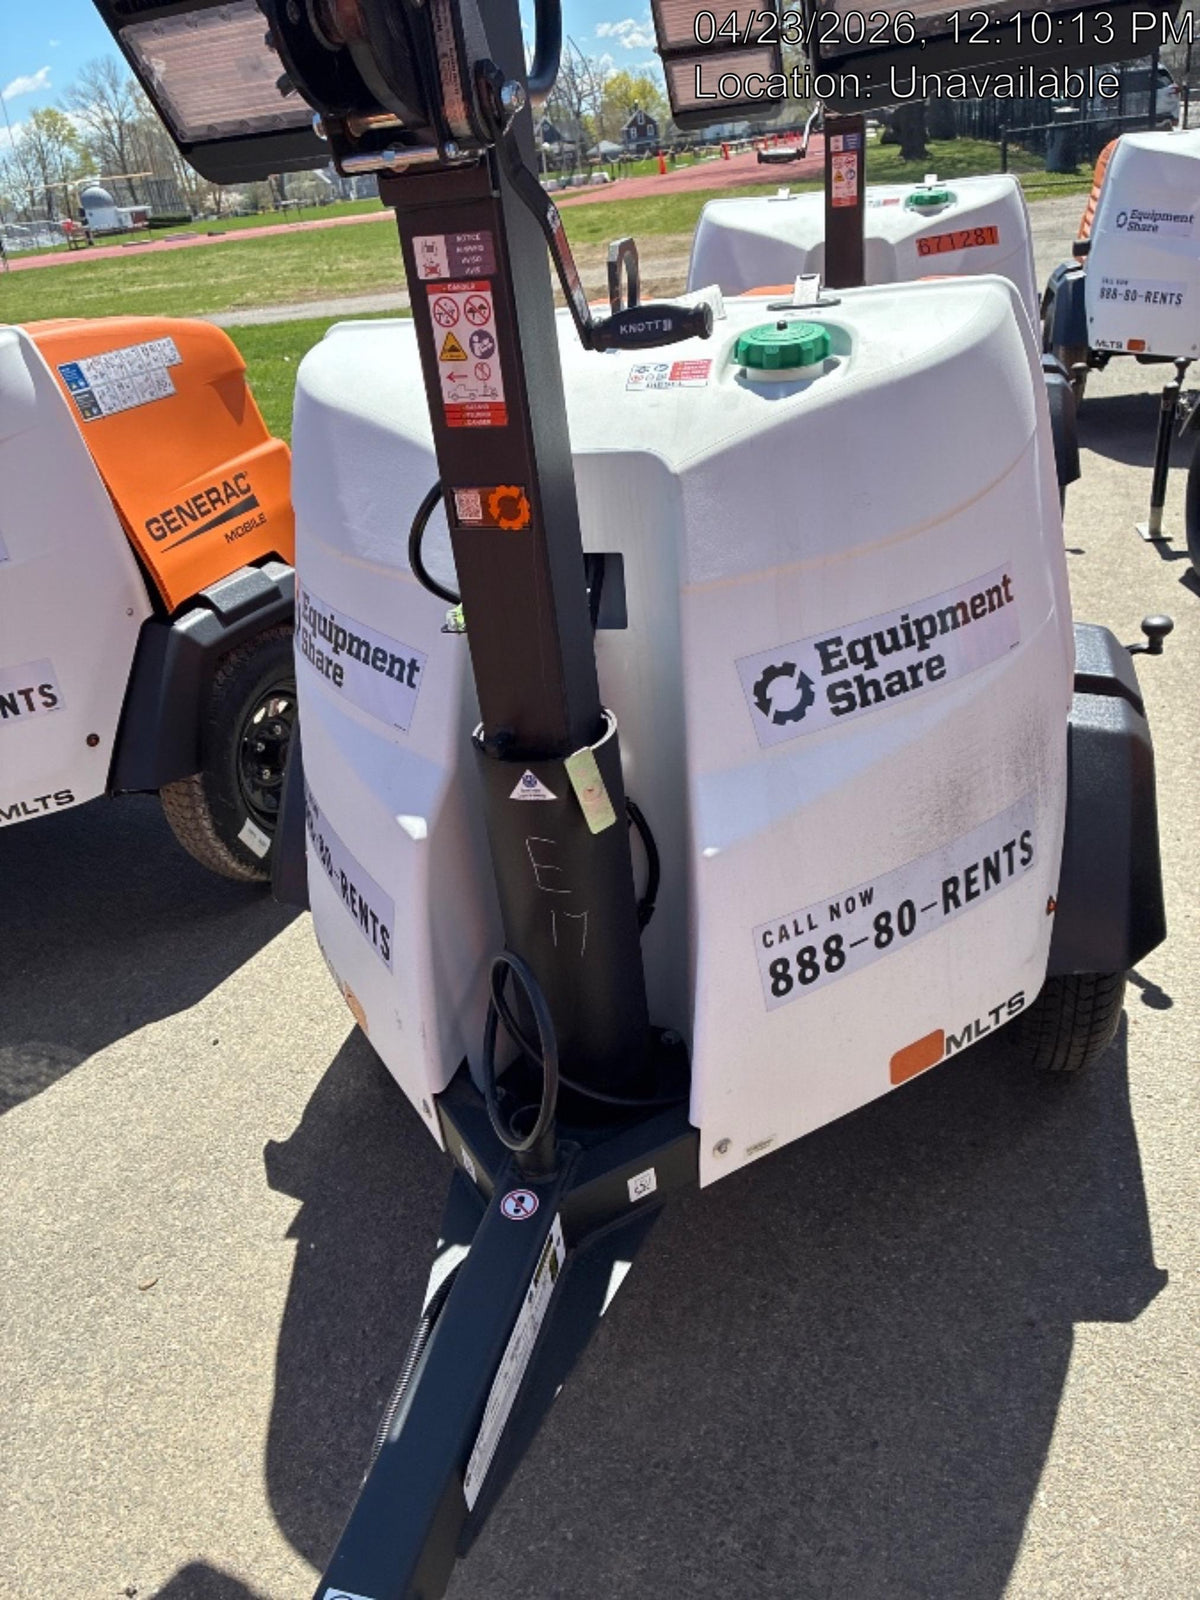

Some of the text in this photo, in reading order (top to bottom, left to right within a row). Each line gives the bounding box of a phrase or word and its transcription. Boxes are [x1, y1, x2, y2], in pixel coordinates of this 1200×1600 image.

[917, 227, 995, 254] 671281
[1127, 221, 1158, 233] Share
[1130, 209, 1194, 226] Equipment
[1100, 287, 1183, 306] 888-80-RENTS
[620, 320, 661, 335] KNOTT
[1095, 339, 1123, 350] MLTS
[145, 472, 251, 542] GENERAC
[224, 513, 268, 544] MOBILE
[301, 588, 420, 690] Equipment
[814, 574, 1014, 676] Equipment
[301, 625, 345, 689] Share
[826, 653, 947, 717] Share
[525, 836, 572, 893] E
[762, 887, 875, 948] CALL NOW
[769, 830, 1034, 998] 888-80-RENTS
[945, 990, 1026, 1055] MLTS
